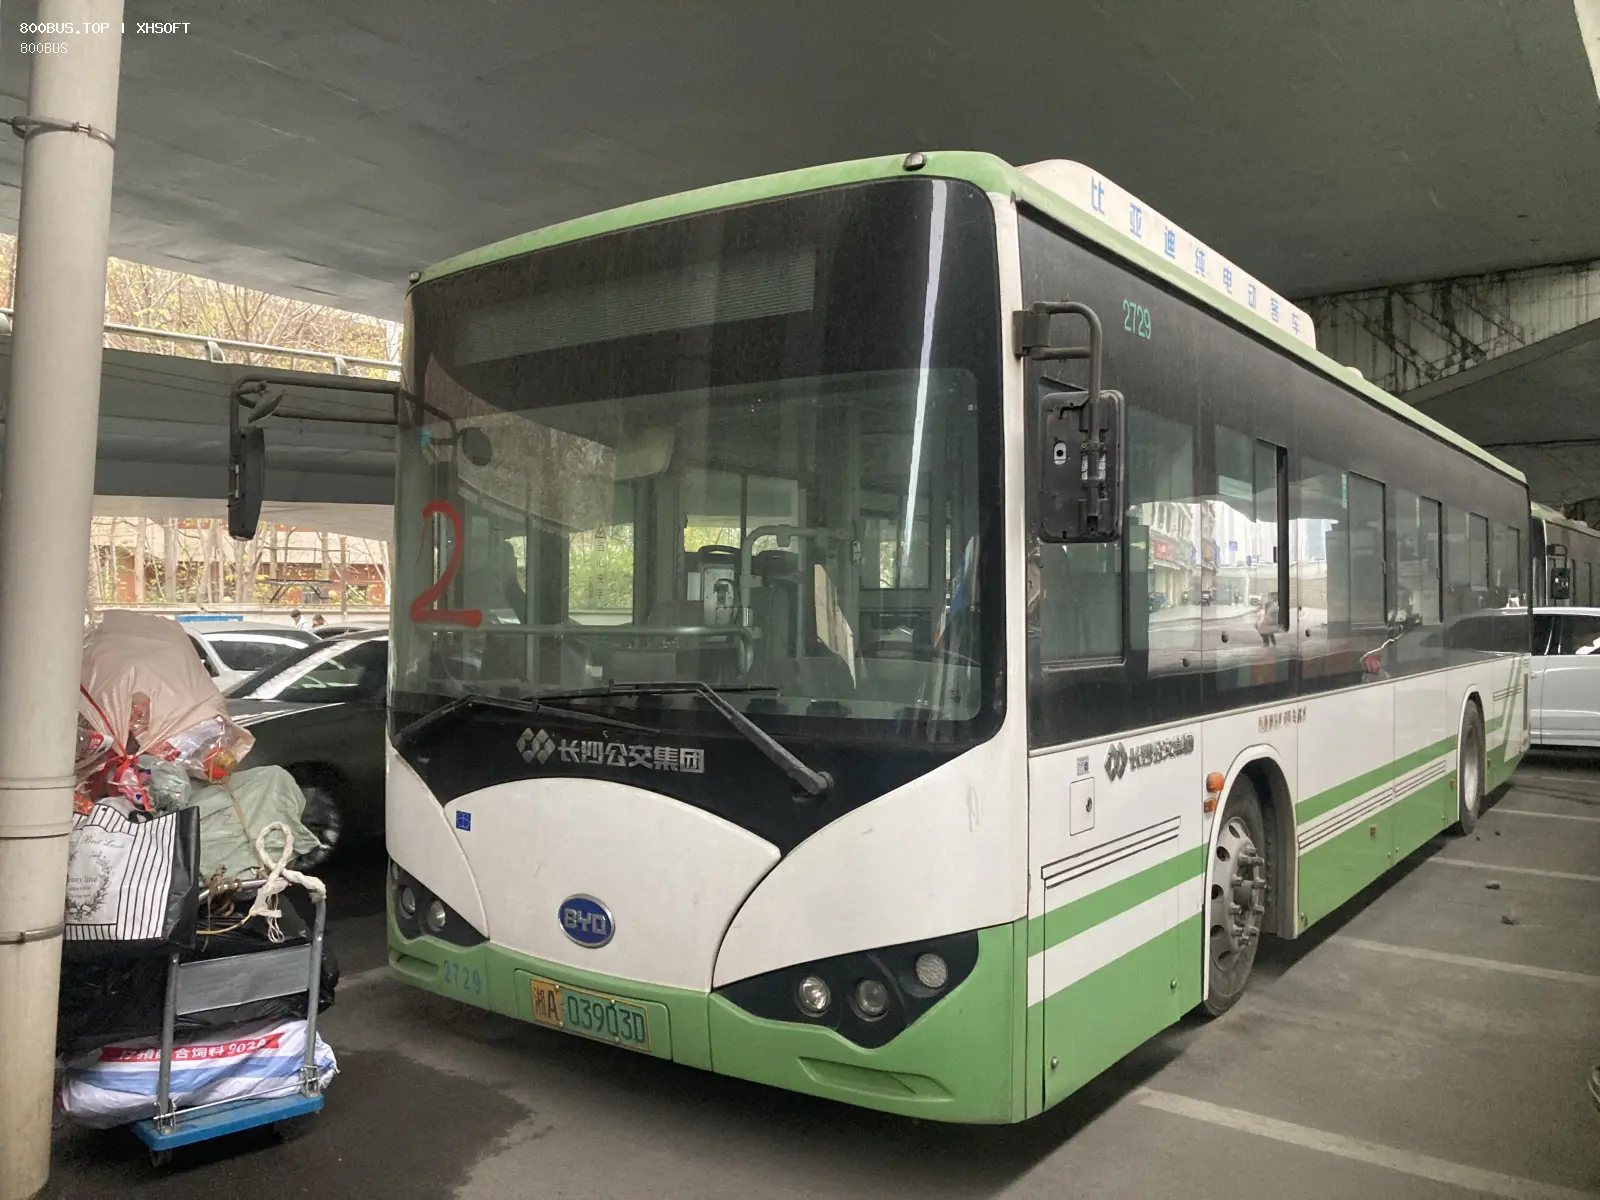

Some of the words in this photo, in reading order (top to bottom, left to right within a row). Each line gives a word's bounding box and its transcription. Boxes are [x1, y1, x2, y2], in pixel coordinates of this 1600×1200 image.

[1122, 298, 1152, 340] 2729
[409, 498, 483, 627] 2
[557, 738, 705, 773] 长沙公交集团
[564, 907, 606, 935] BYD
[443, 959, 481, 996] 2729
